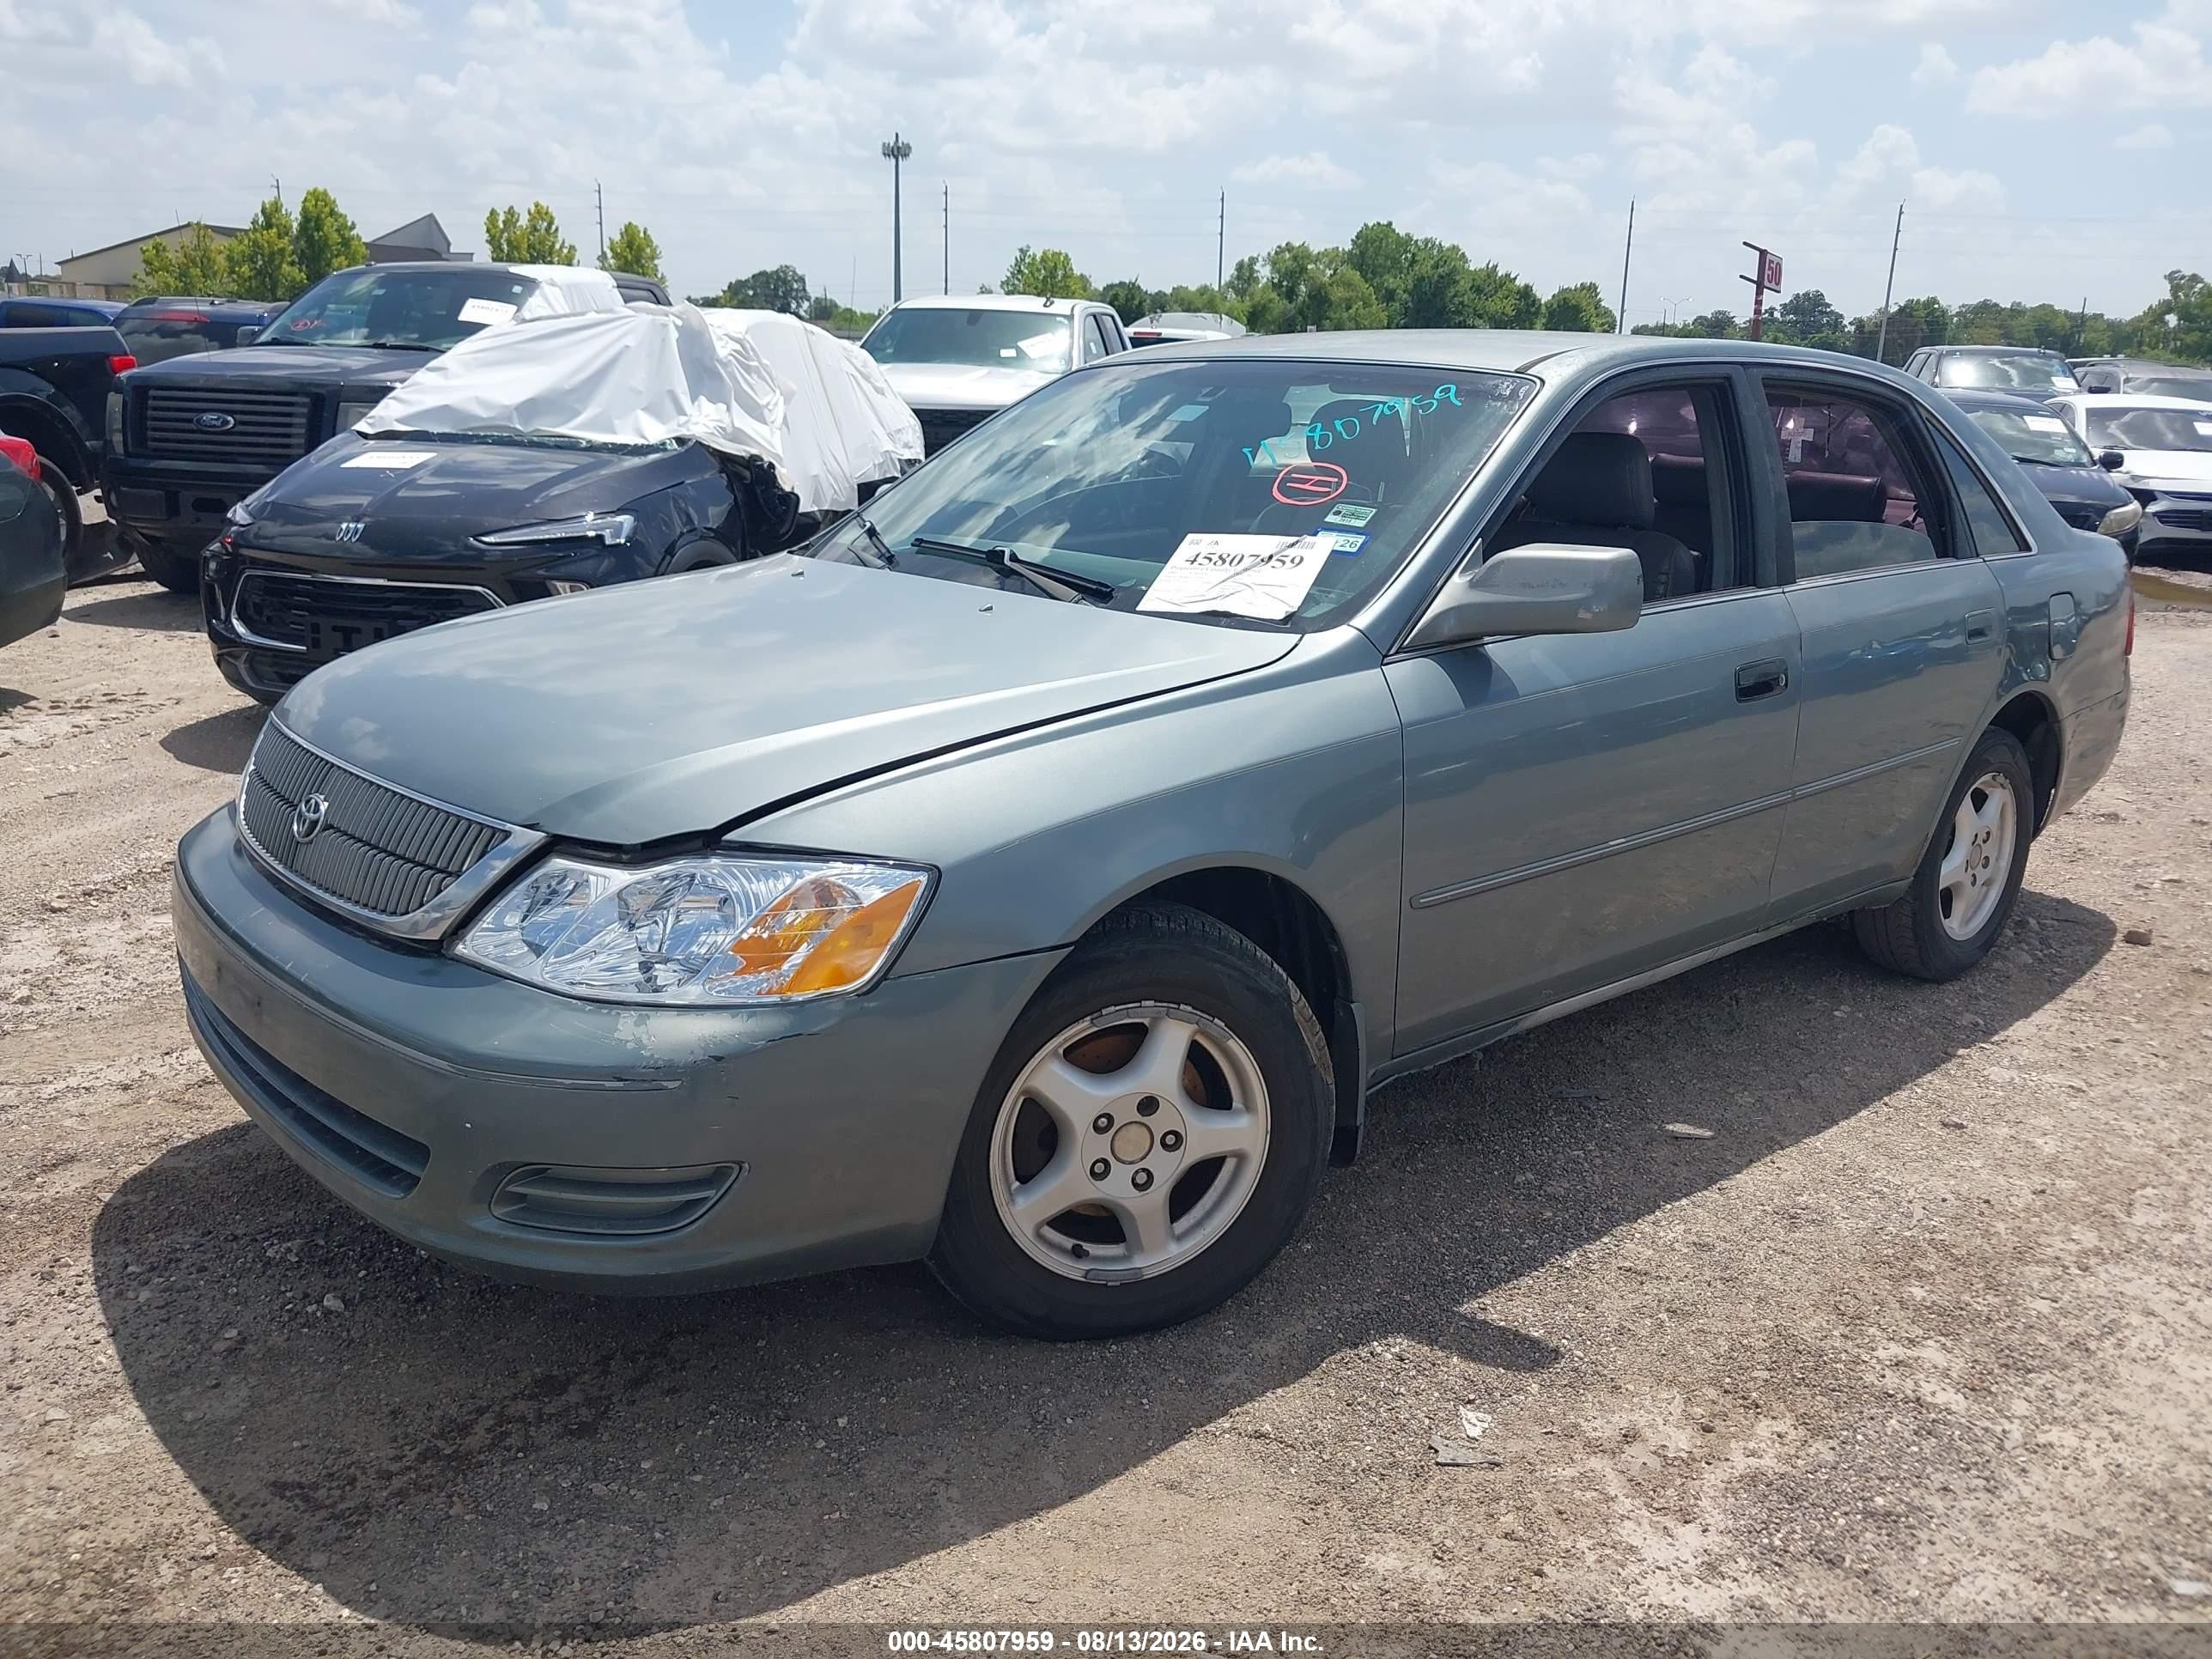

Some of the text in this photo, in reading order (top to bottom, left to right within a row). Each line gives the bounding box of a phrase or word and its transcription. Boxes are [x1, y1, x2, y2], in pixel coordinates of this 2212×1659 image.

[1766, 258, 1782, 286] 50
[1340, 538, 1359, 549] 26
[1184, 550, 1305, 570] 45807959
